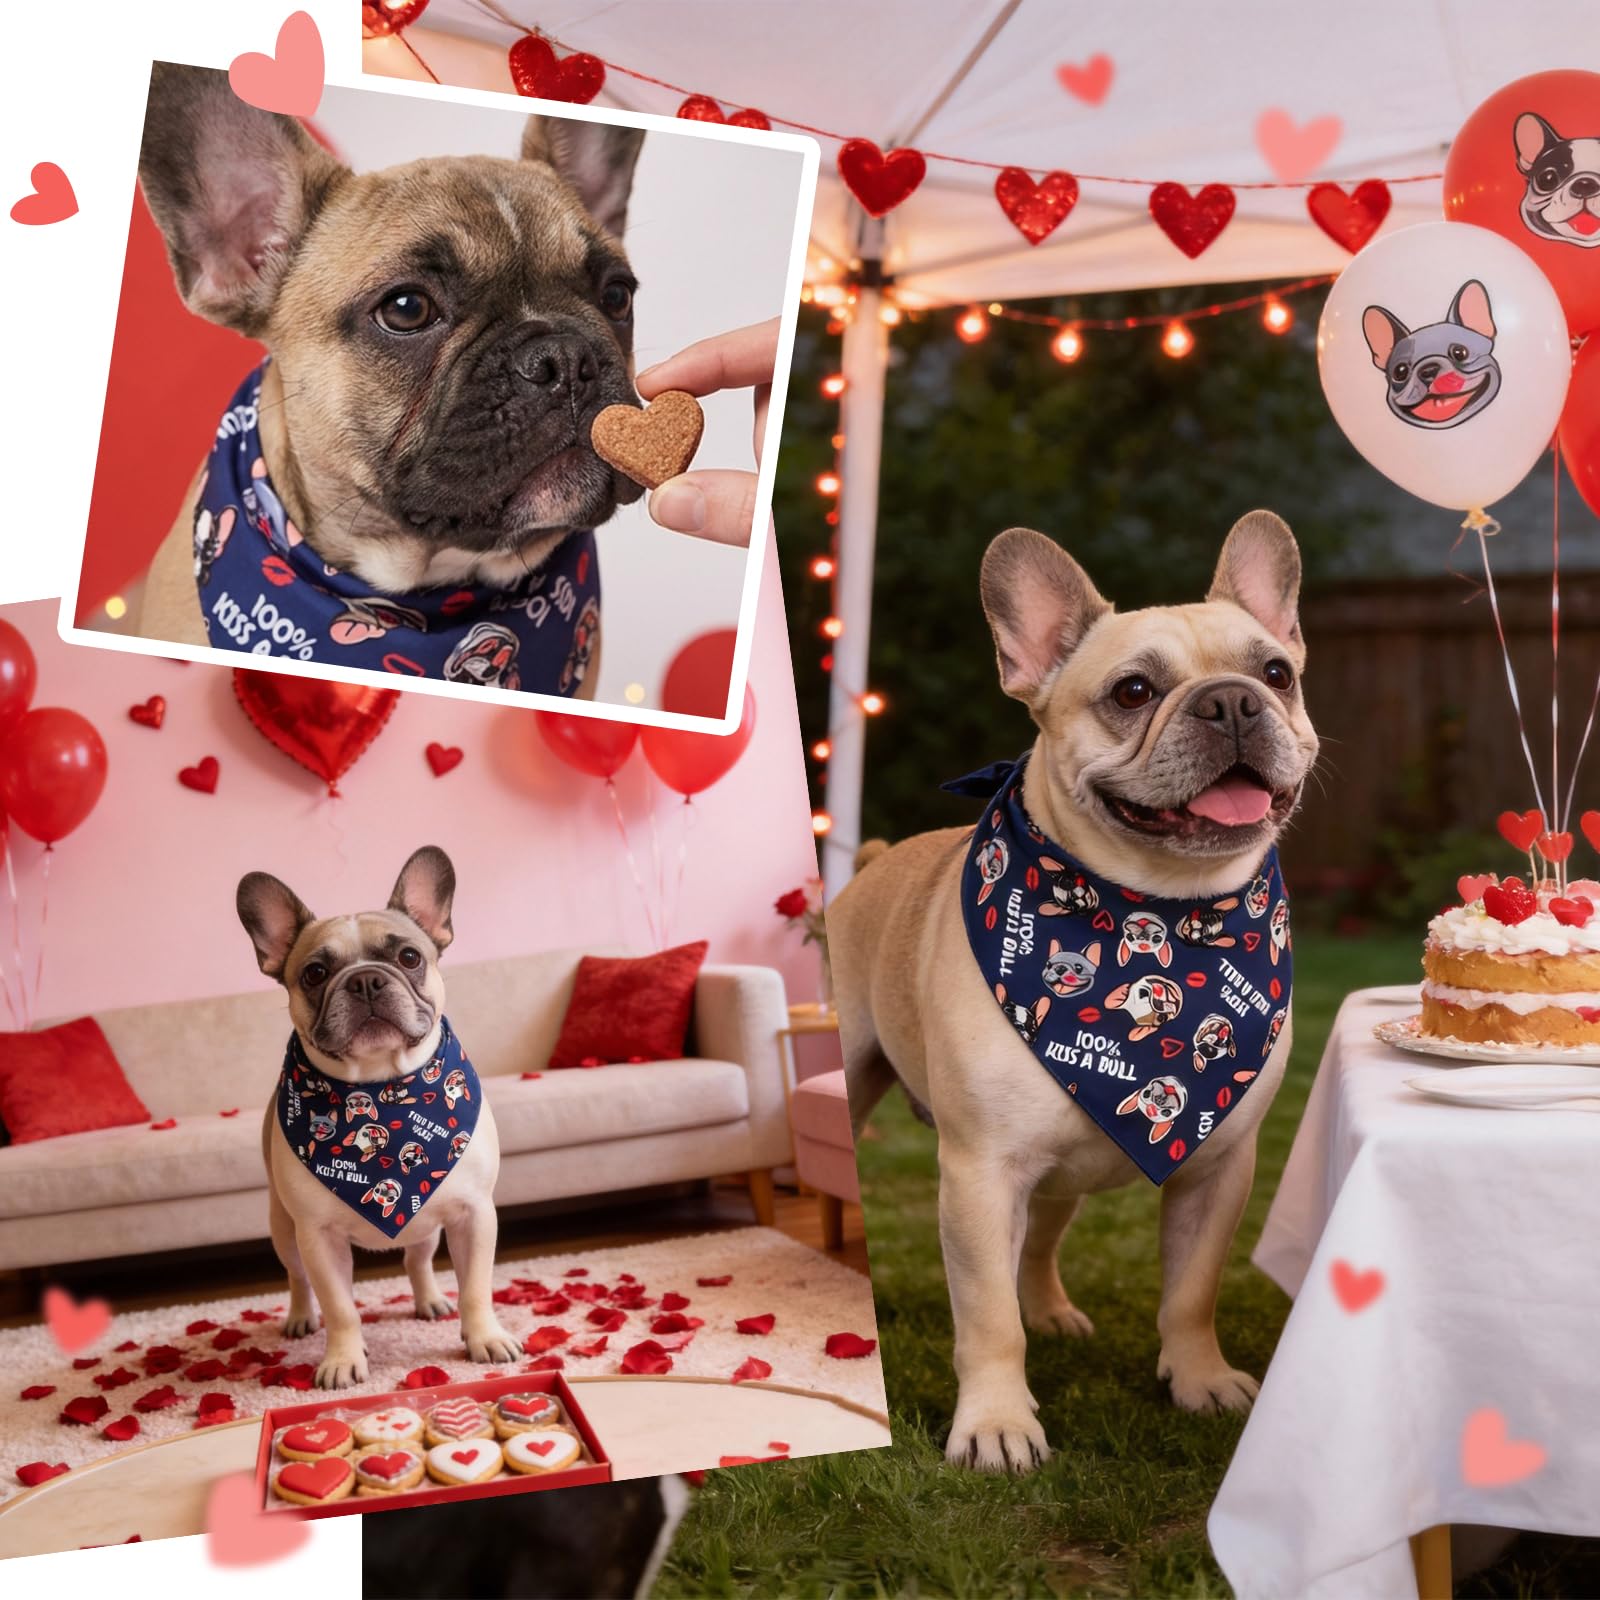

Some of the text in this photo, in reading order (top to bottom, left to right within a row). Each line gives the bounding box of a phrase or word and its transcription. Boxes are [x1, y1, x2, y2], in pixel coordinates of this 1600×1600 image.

[250, 593, 318, 661] 100%
[1075, 1030, 1121, 1056] 100%
[1080, 1052, 1093, 1070] A
